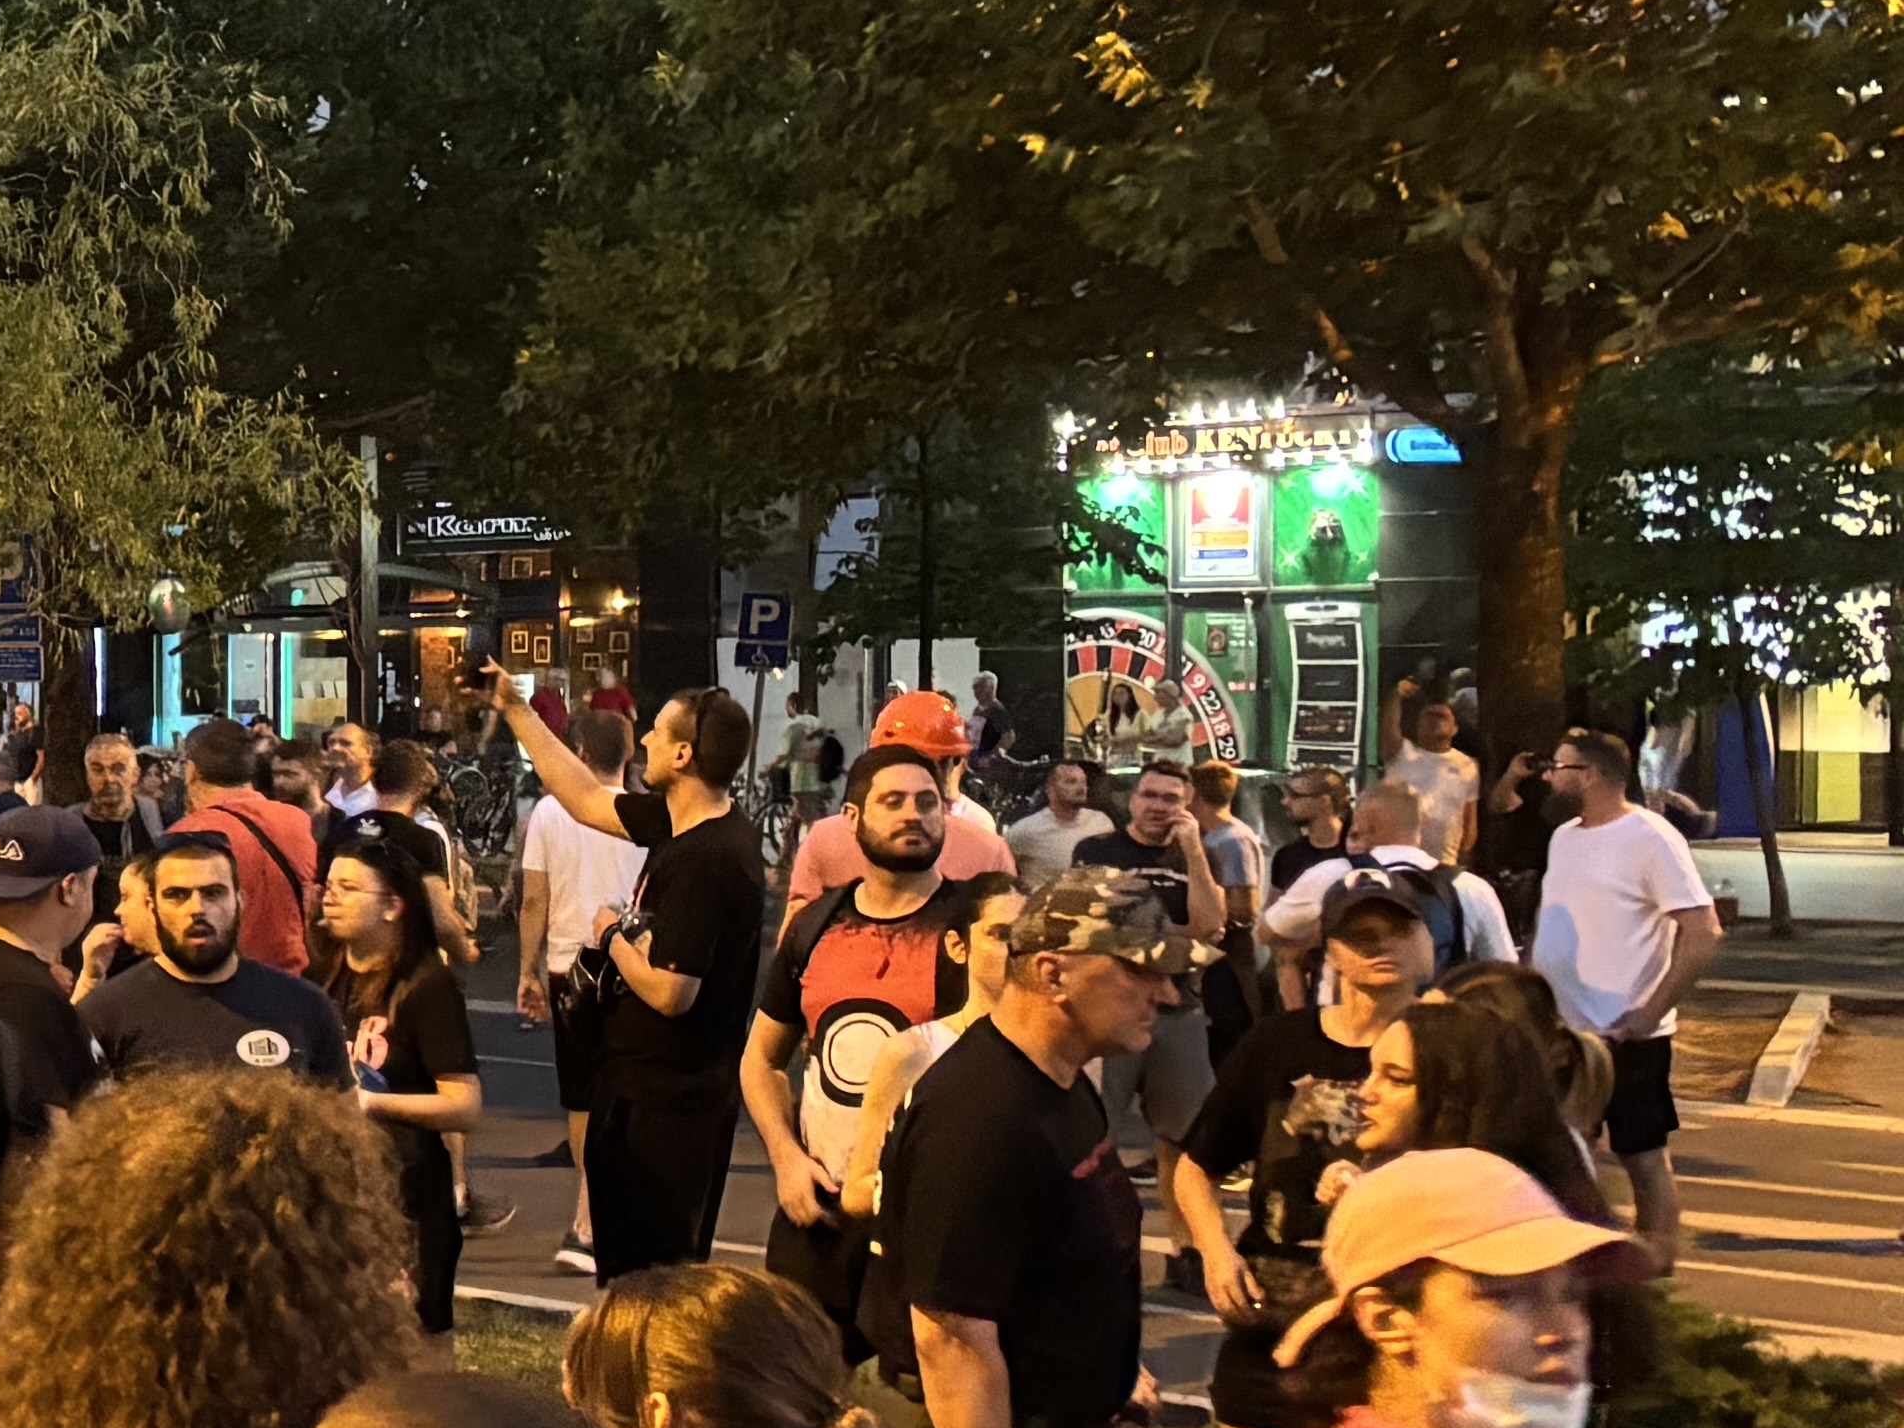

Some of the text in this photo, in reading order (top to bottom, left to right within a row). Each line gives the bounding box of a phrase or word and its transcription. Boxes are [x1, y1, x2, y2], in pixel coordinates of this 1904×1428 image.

[749, 598, 781, 635] P
[1200, 690, 1222, 716] 22
[1217, 736, 1238, 760] 29
